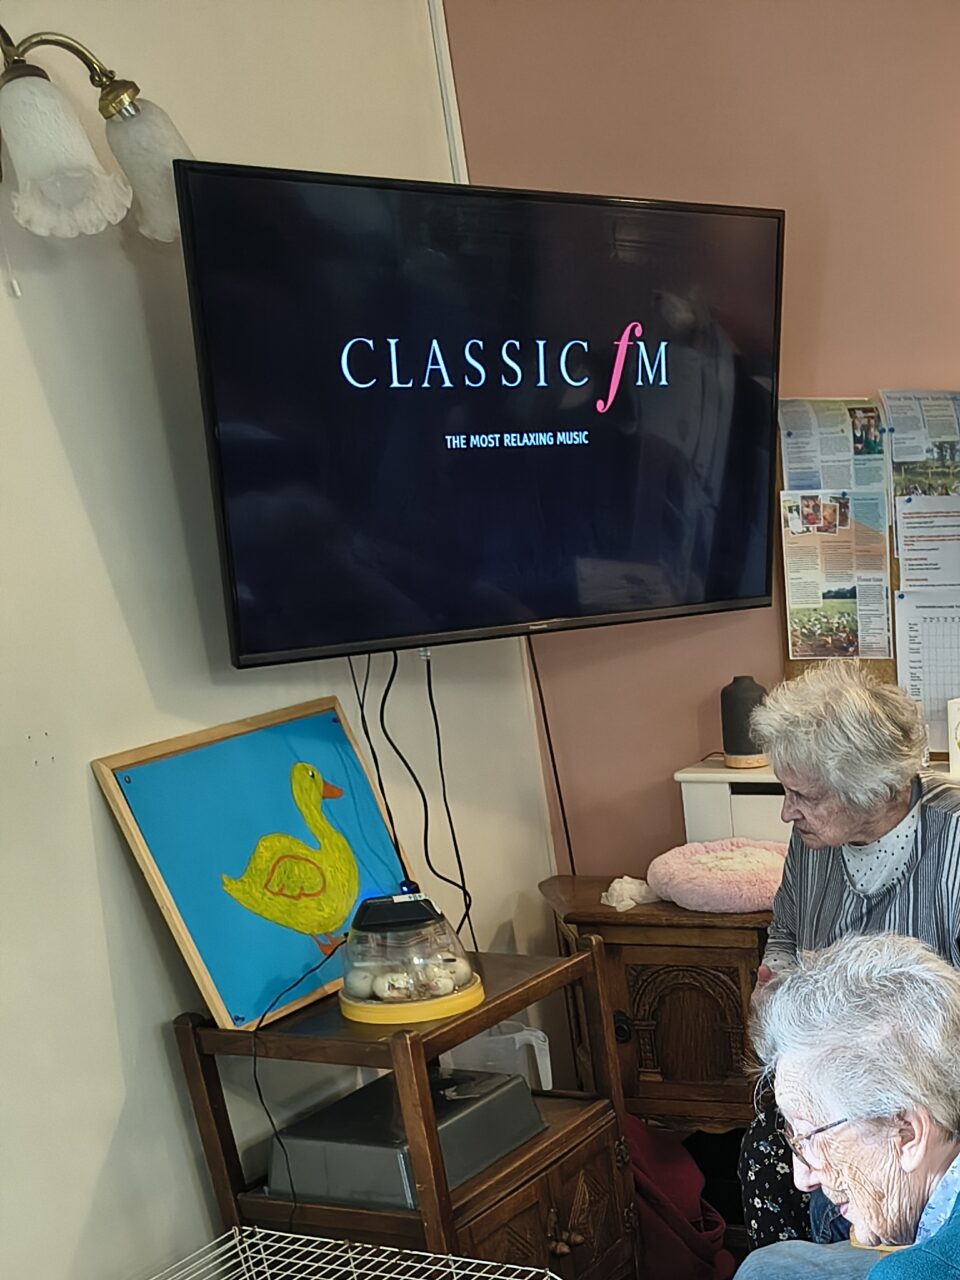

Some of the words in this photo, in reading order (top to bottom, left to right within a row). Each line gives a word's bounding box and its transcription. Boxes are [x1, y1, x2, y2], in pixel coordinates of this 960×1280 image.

[340, 337, 590, 389] CLASSIC
[445, 434, 467, 449] THE
[470, 434, 501, 449] MOST
[503, 432, 554, 448] RELAXING
[556, 430, 590, 446] MUSIC
